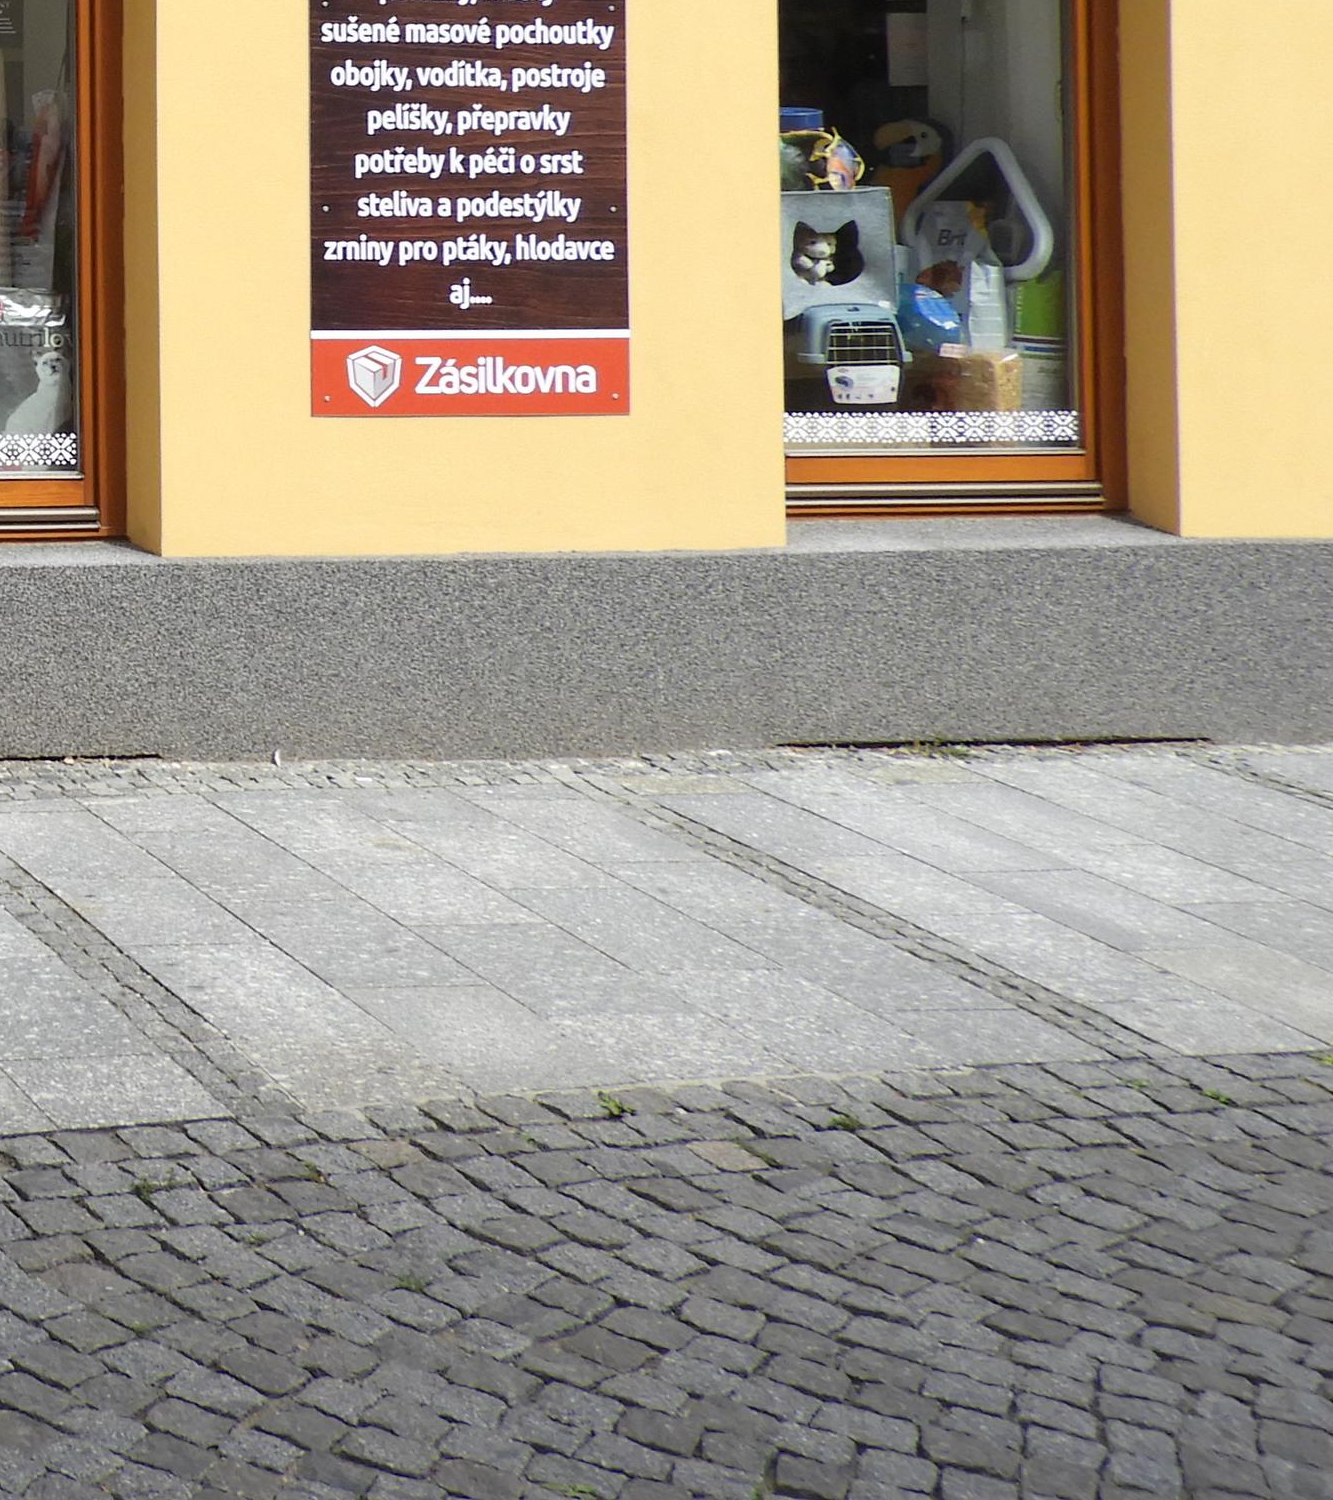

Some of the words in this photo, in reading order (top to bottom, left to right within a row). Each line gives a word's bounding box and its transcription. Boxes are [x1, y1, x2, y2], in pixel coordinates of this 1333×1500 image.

[321, 15, 400, 44] sušené
[404, 16, 491, 44] masové
[495, 18, 614, 50] pochoutky
[330, 59, 413, 92] obojky,
[416, 59, 508, 92] vodítka,
[511, 61, 606, 93] postroje
[366, 103, 453, 136] pelíšky,
[457, 104, 571, 136] přepravky
[355, 146, 445, 179] potřeby
[450, 147, 464, 173] k
[469, 146, 515, 179] péči
[519, 155, 532, 174] o
[540, 150, 584, 174] srst
[357, 190, 432, 217] steliva
[437, 198, 451, 218] a
[456, 191, 581, 223] podestýlky
[323, 234, 394, 266] zrniny
[399, 241, 437, 266] pro
[443, 233, 511, 266] ptáky,
[515, 234, 615, 262] hlodavce
[414, 355, 598, 395] Zásilkovna
